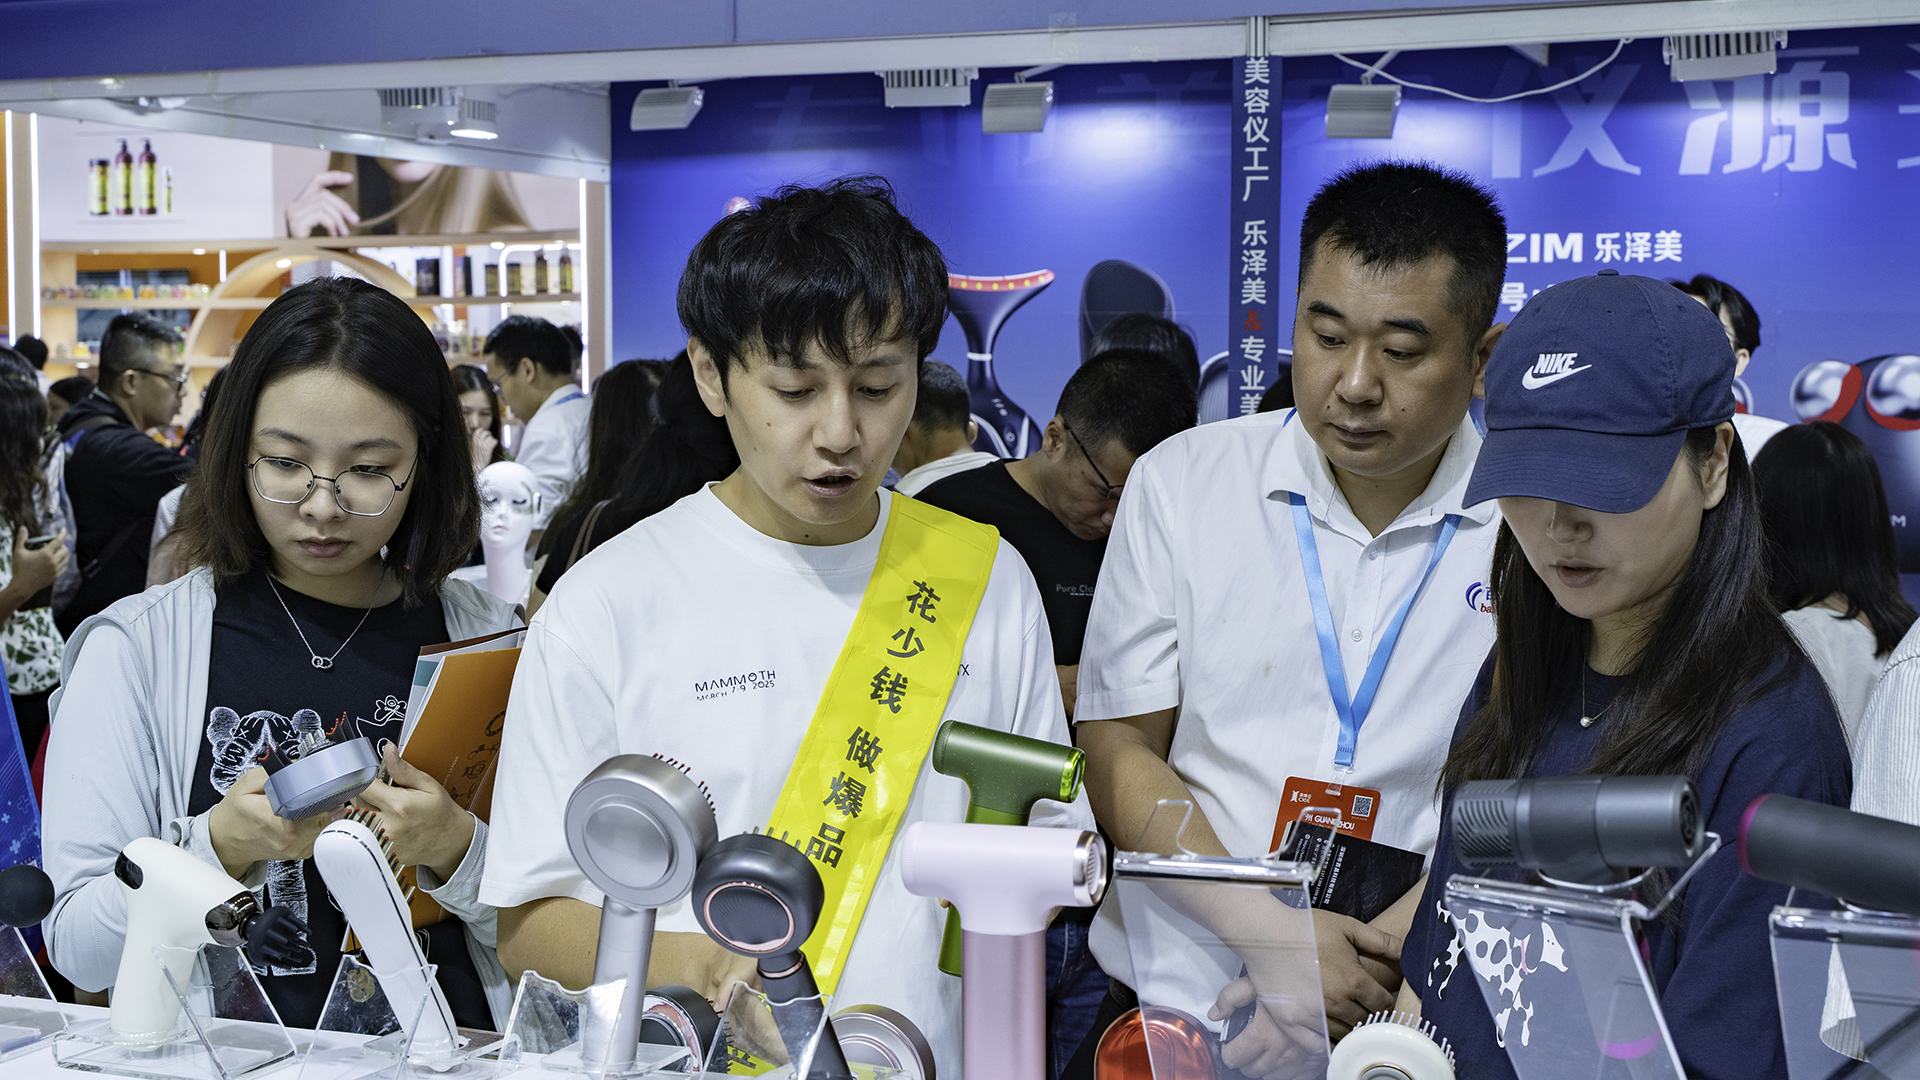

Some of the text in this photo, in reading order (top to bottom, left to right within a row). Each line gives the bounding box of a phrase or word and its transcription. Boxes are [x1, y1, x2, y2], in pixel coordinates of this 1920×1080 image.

[1242, 57, 1270, 202] 美容仪工厂
[1594, 230, 1683, 263] 乐泽美
[1533, 352, 1578, 374] NIKE
[1055, 584, 1077, 592] Pure
[694, 670, 776, 693] MAMMOTH
[752, 680, 775, 690] 2025
[806, 579, 941, 869] 花少钱 做爆品
